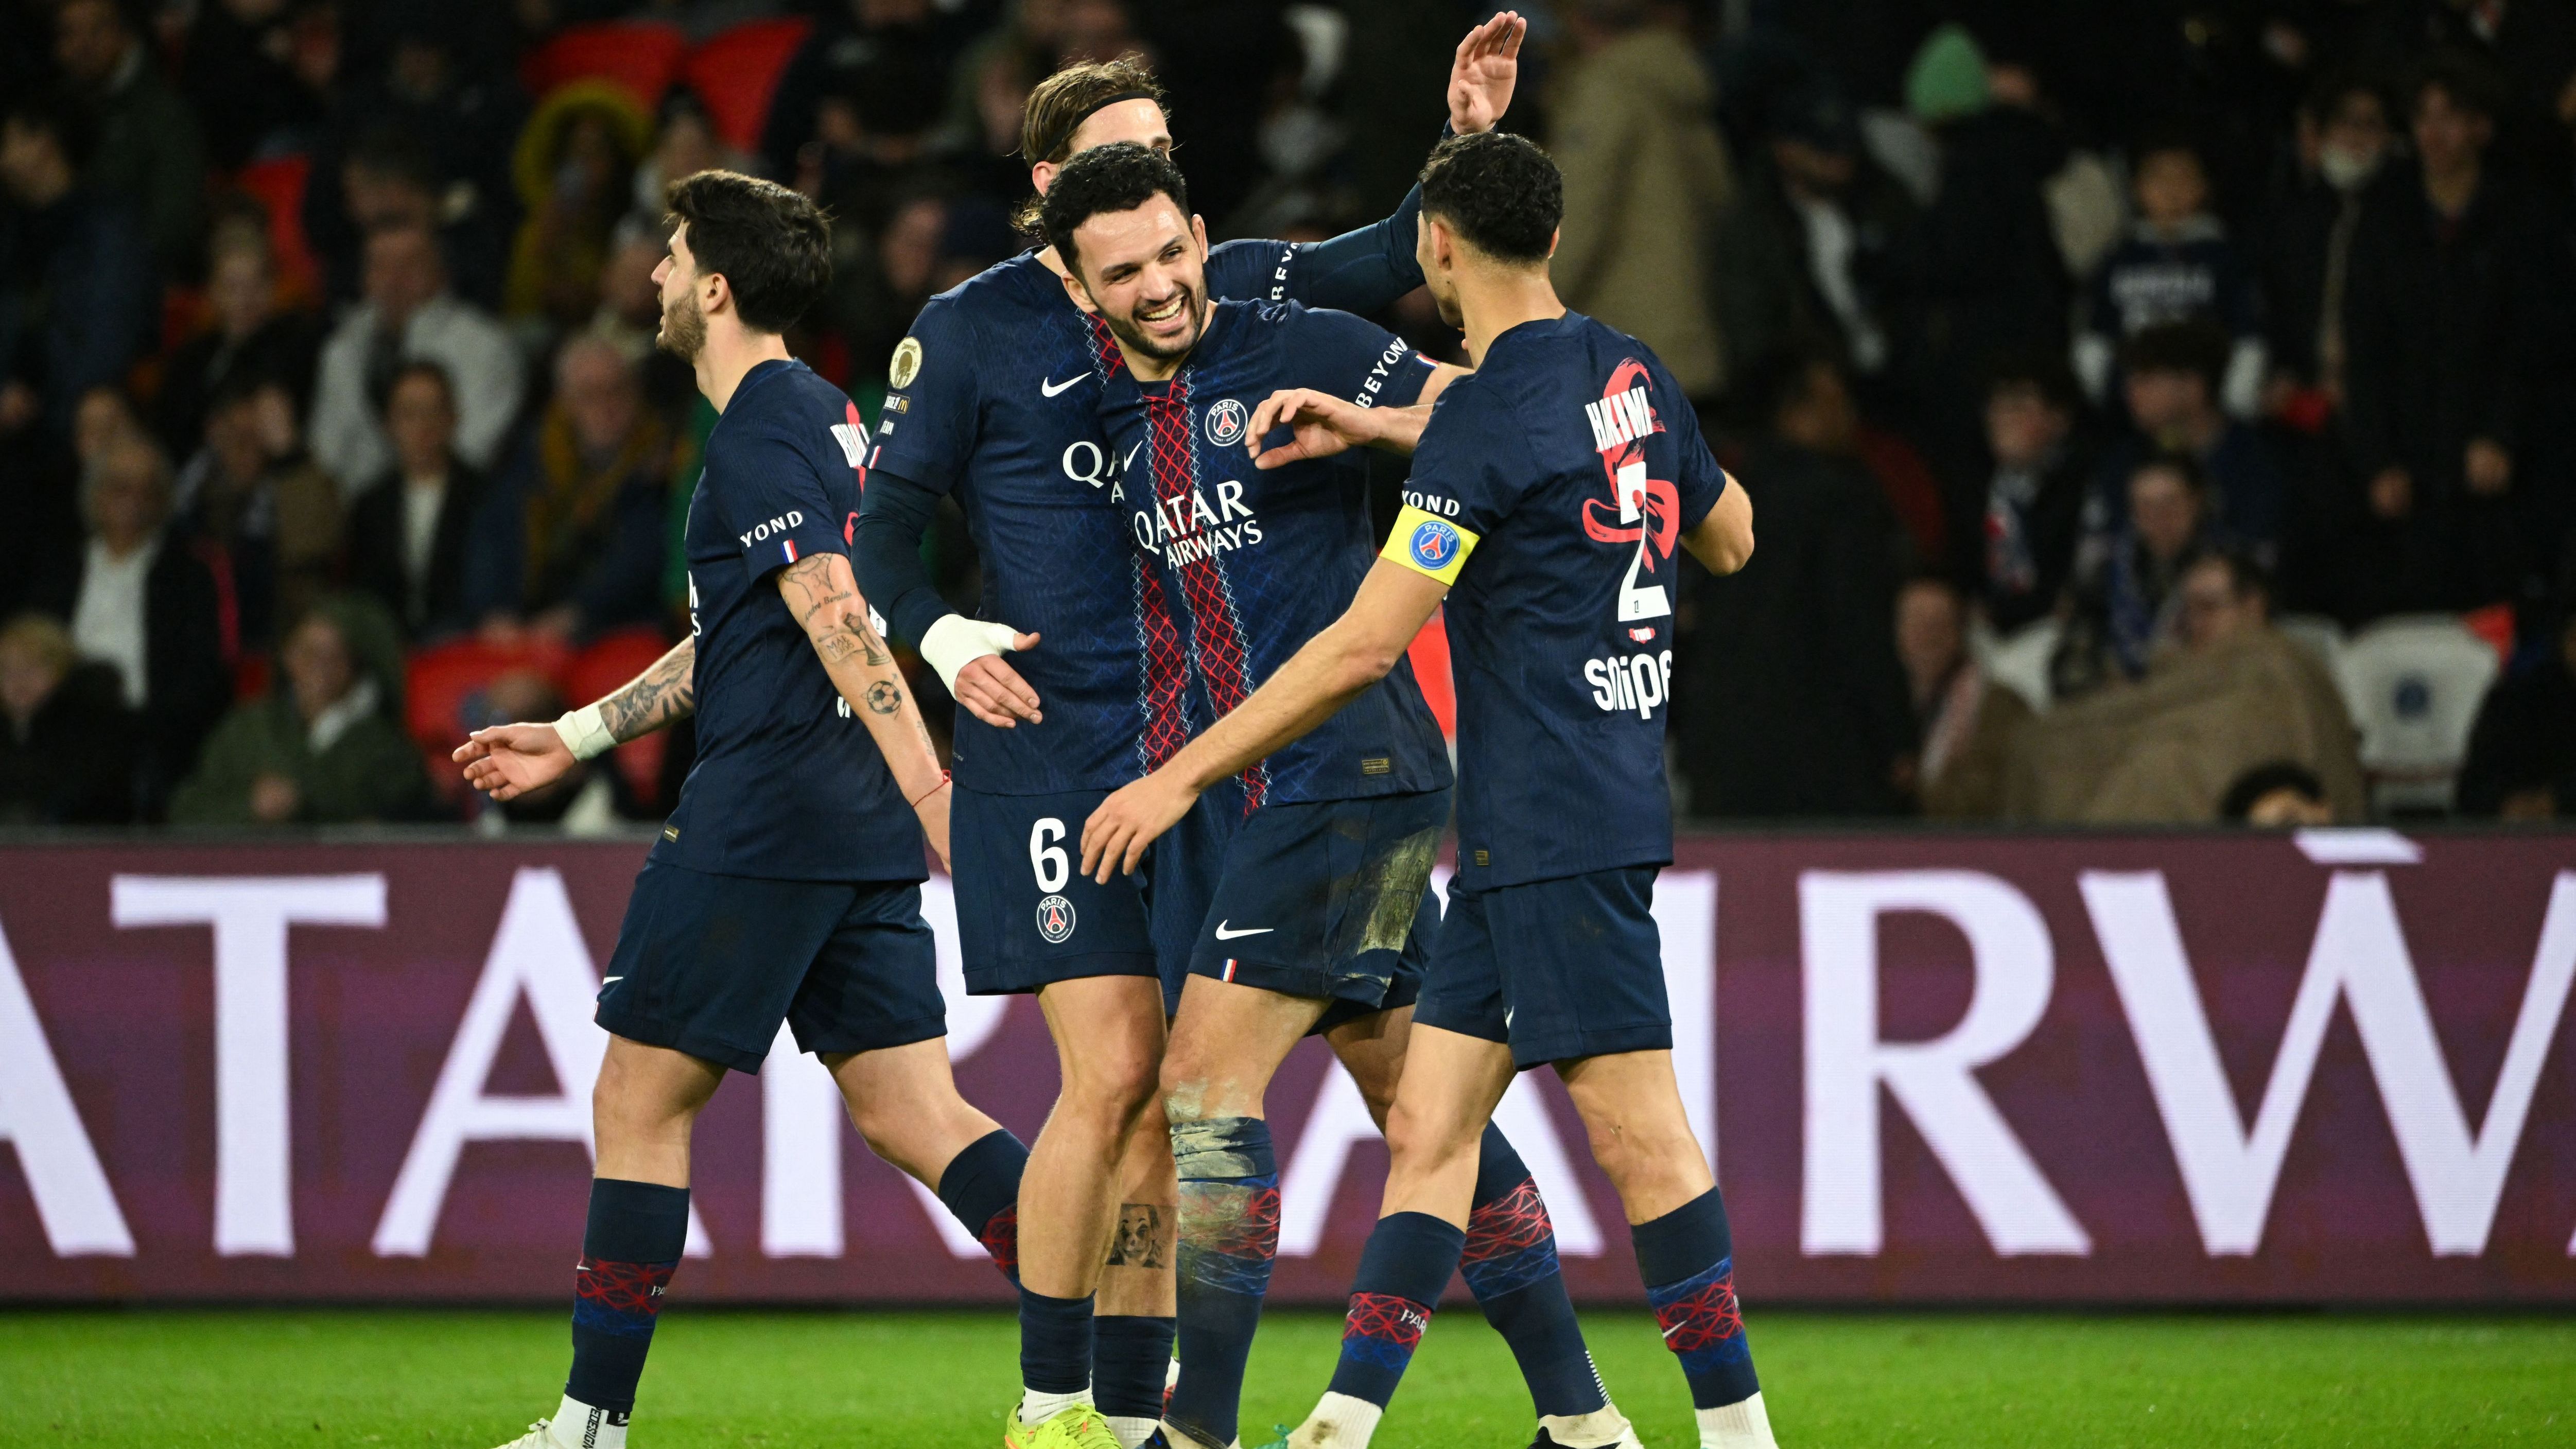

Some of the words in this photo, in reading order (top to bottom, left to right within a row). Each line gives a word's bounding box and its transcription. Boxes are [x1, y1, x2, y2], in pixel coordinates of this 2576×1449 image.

[1211, 401, 1239, 416] PARIS
[740, 511, 803, 548] YOND
[1135, 480, 1254, 555] QATAR
[1424, 524, 1456, 543] PARIS
[1165, 519, 1263, 570] AIRWAYS
[1617, 461, 1671, 622] 2
[1030, 817, 1069, 893] 6
[1040, 898, 1067, 911] PARIS
